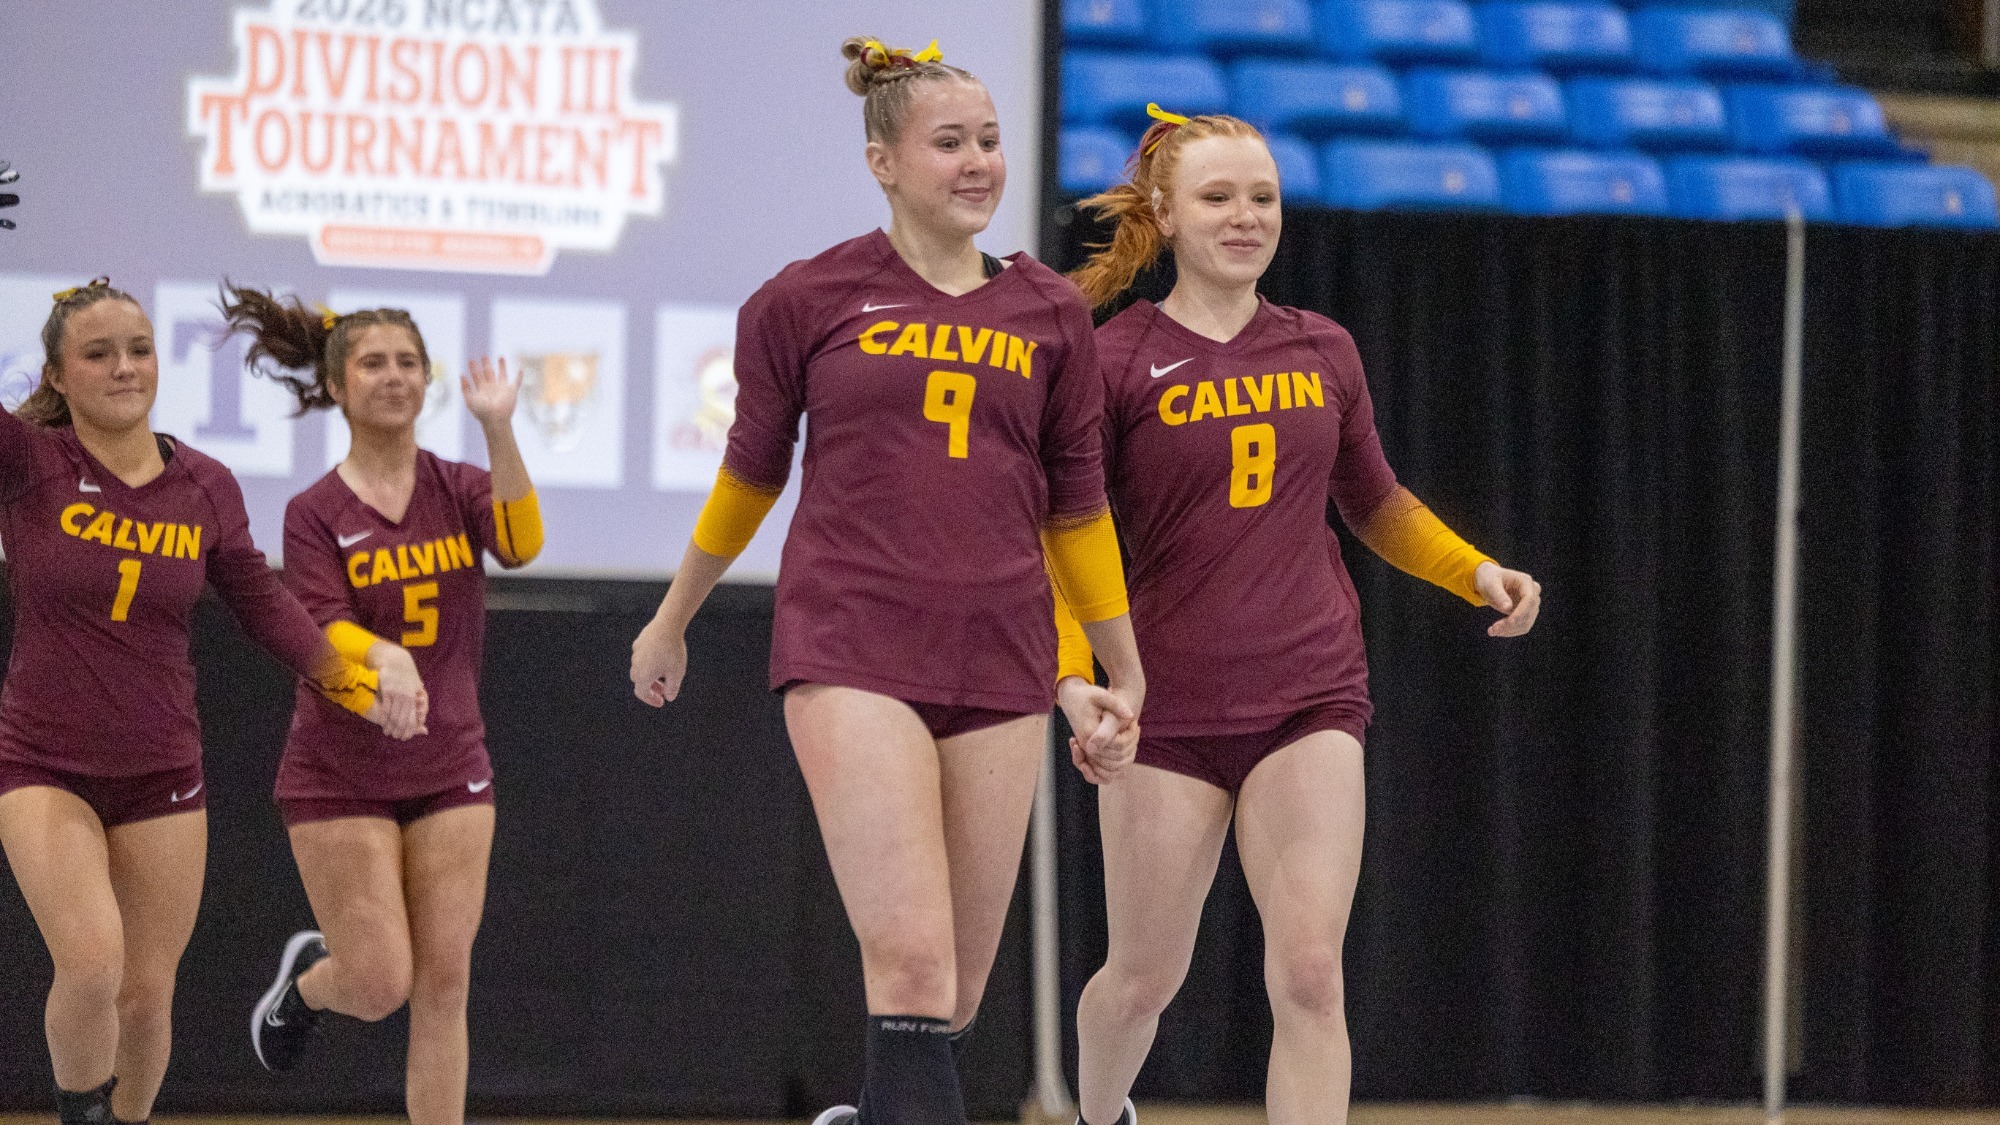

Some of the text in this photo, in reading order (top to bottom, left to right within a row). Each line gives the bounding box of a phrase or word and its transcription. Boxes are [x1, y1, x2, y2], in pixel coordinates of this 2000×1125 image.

[246, 25, 622, 115] DIVISION III
[202, 94, 662, 198] TOURNAMENT
[858, 321, 1037, 379] CALVIN
[923, 370, 976, 458] 9
[1158, 372, 1325, 426] CALVIN
[1230, 423, 1276, 508] 8
[60, 503, 201, 560] CALVIN
[347, 534, 473, 588] CALVIN
[111, 559, 141, 621] 1
[402, 582, 439, 647] 5
[881, 1021, 916, 1032] RUN
